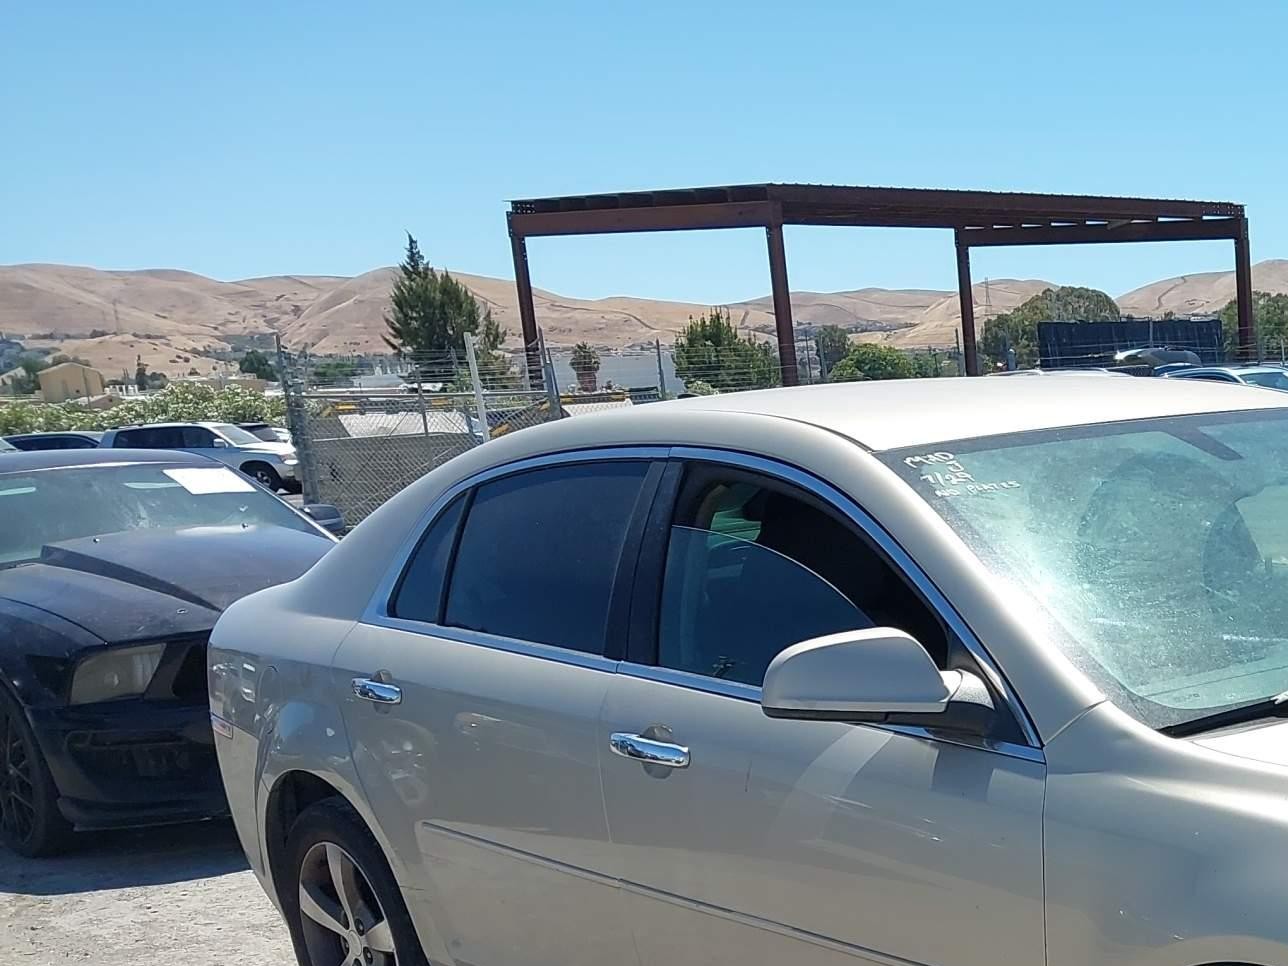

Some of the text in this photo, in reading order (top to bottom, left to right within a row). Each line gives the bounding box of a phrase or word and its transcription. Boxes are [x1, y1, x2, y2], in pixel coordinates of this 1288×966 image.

[920, 471, 975, 487] 7/29
[934, 480, 1021, 497] NO PLATES
